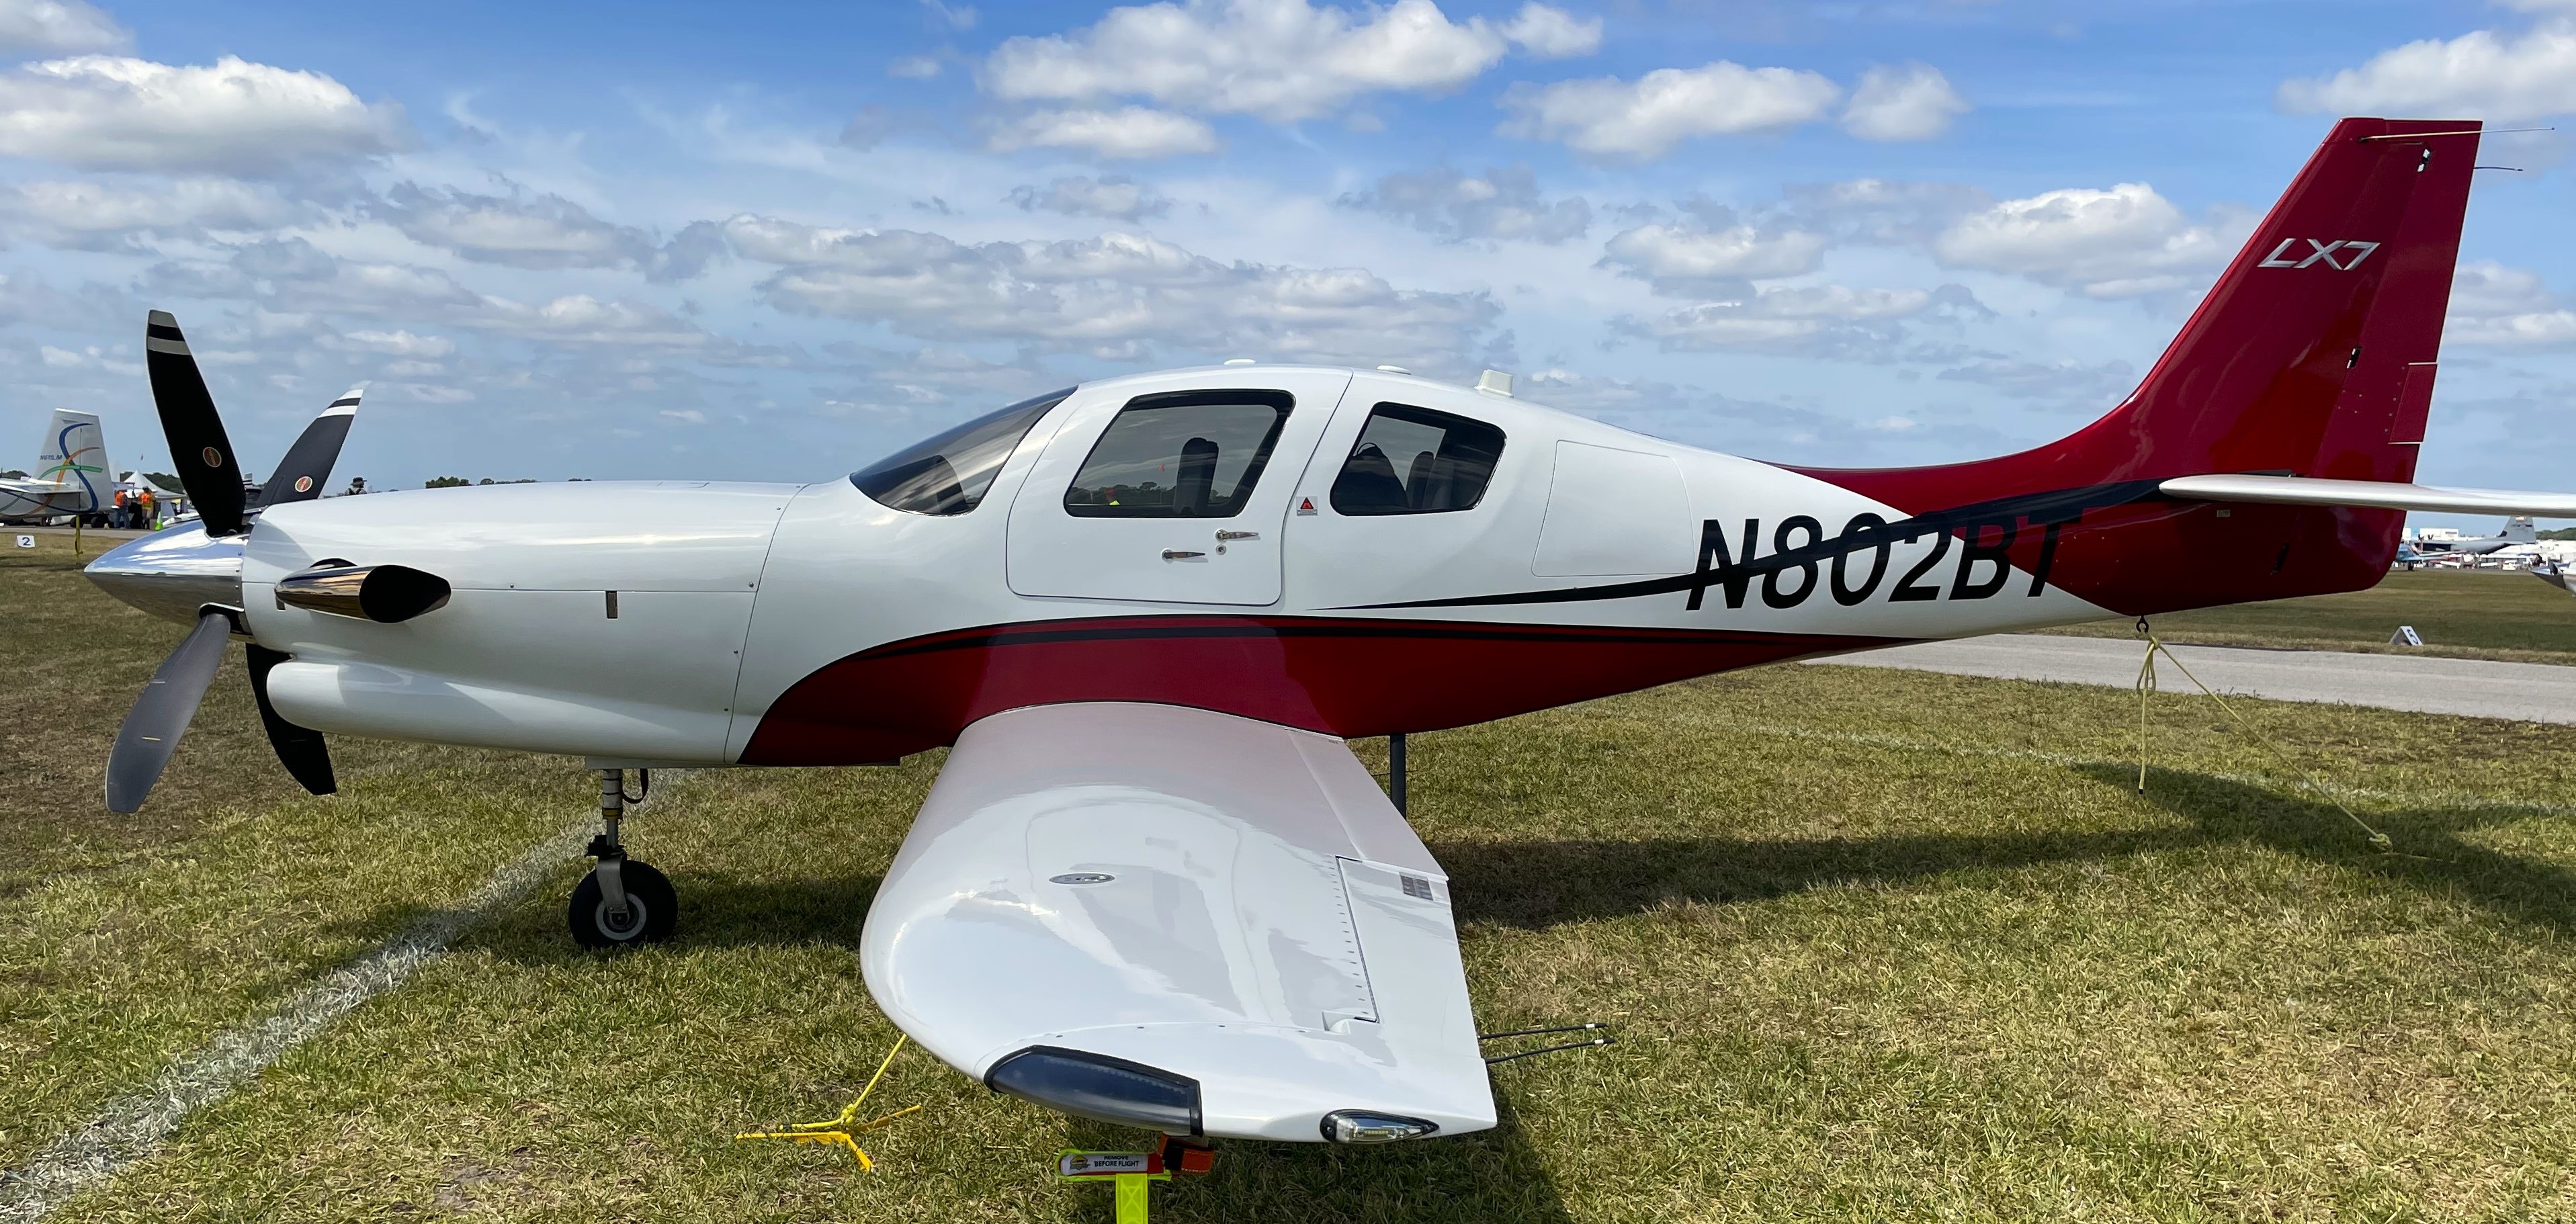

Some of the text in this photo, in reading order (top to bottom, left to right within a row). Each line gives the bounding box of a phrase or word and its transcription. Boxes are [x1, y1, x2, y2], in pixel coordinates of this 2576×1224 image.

[2258, 237, 2380, 270] LX7
[22, 537, 30, 545] 2
[1686, 512, 2084, 611] N802BT
[2407, 629, 2419, 644] 5
